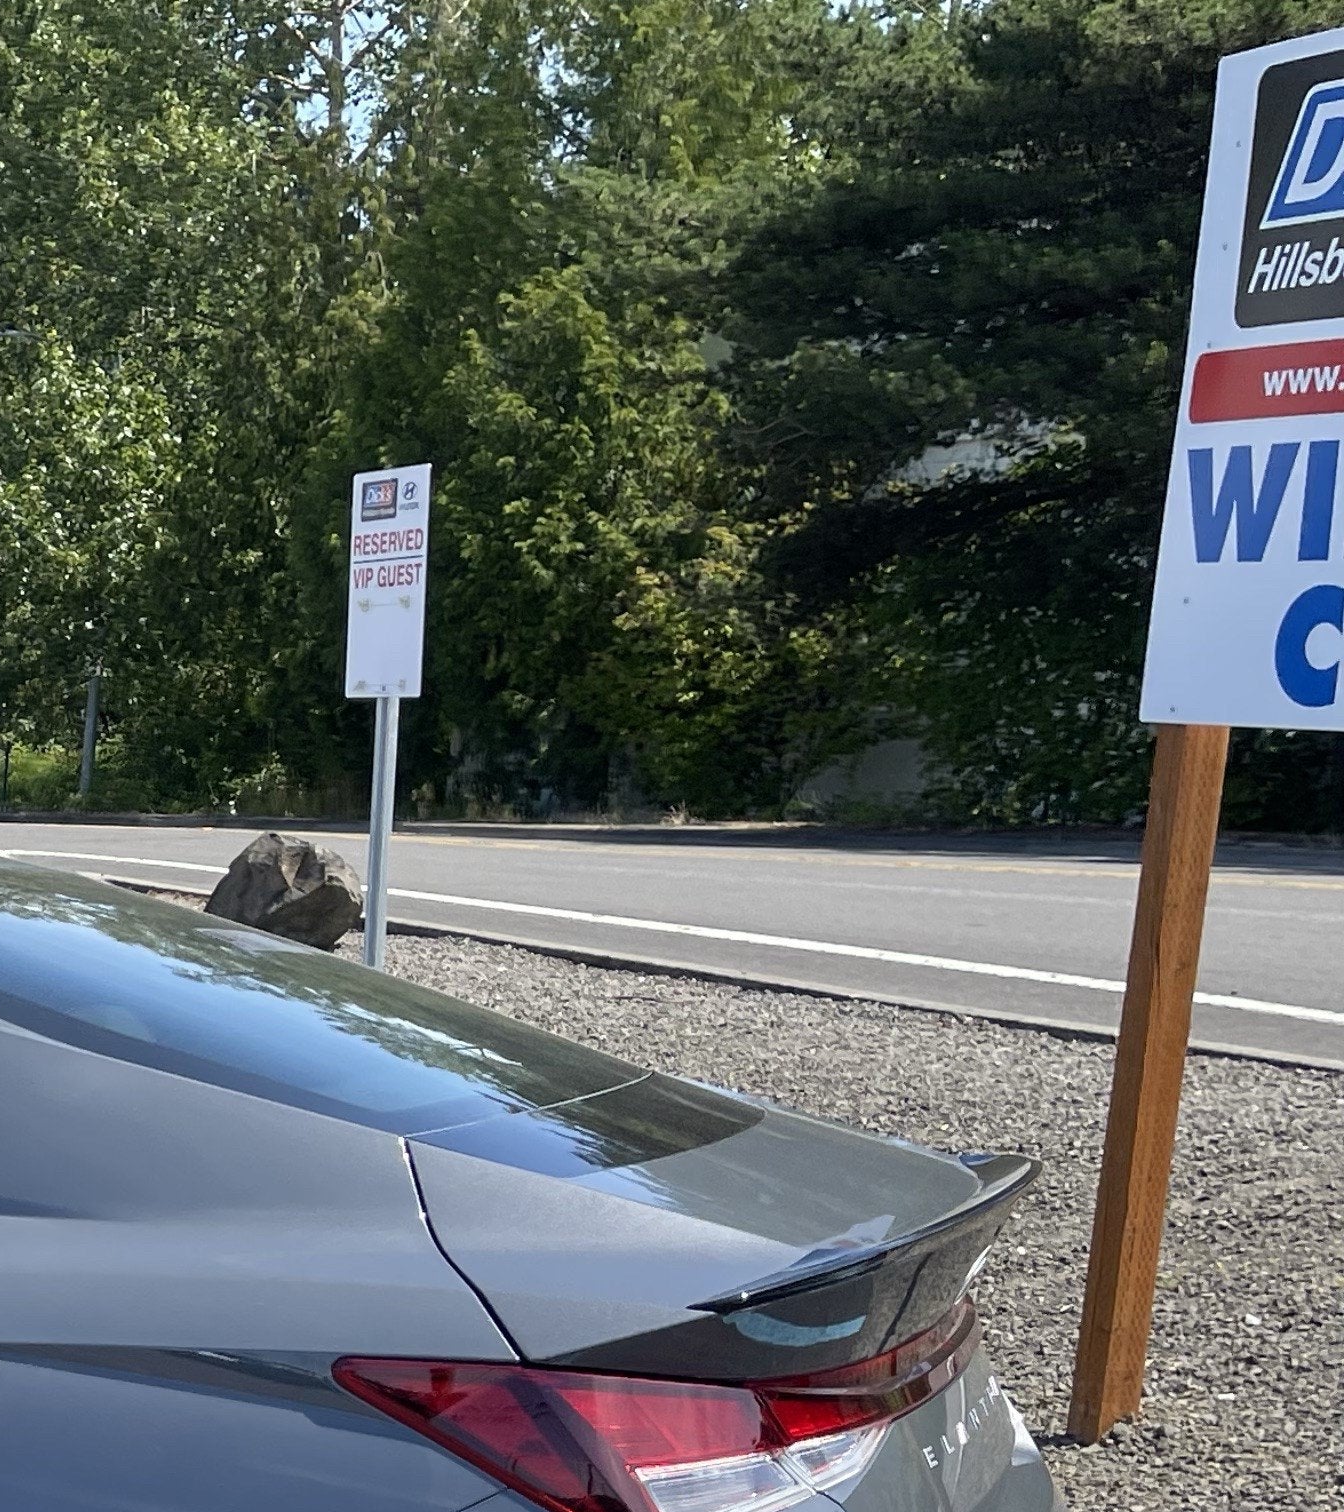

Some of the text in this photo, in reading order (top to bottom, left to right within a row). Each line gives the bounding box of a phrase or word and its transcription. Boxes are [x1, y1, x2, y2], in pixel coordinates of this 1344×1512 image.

[1247, 236, 1344, 294] Hillsb
[353, 528, 424, 556] RESERVED
[353, 563, 423, 589] VIP GUEST
